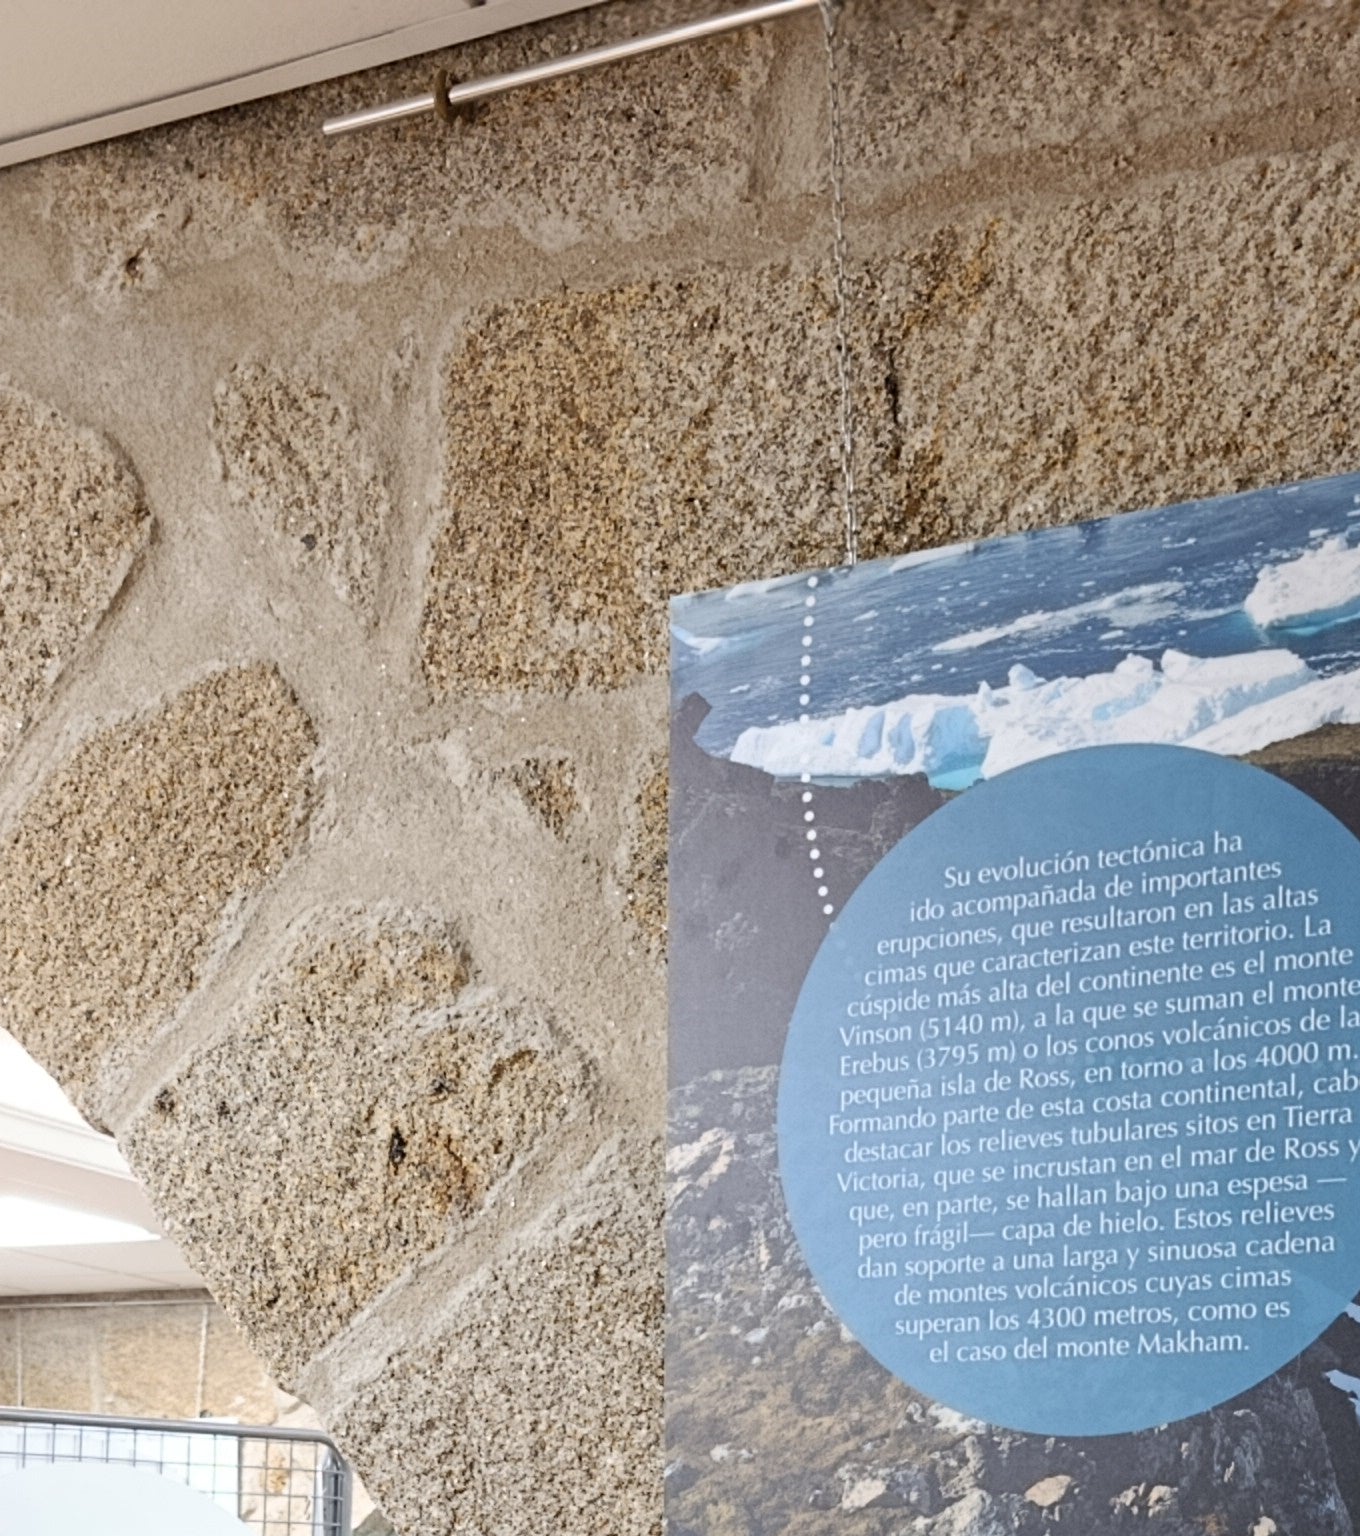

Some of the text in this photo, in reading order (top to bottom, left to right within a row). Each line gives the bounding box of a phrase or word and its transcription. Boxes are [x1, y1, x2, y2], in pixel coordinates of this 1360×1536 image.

[945, 830, 1242, 888] Su evolución tectónica ha
[911, 862, 1282, 922] ido acompañada de importantes
[864, 915, 1331, 986] cimas que caracterizan este territorio. La
[877, 885, 1318, 958] erupciones, que resultaron en las altas
[848, 947, 1354, 1020] cúspide más alta del continente es el monte
[840, 1026, 911, 1046] Vinson
[920, 1014, 983, 1041] (5140
[991, 1011, 1025, 1032] m),
[1034, 1012, 1046, 1027] a
[1056, 1003, 1074, 1025] la
[1083, 1004, 1126, 1029] que
[1134, 1000, 1158, 1017] se
[1166, 991, 1243, 1014] suman
[1252, 980, 1273, 1005] el
[841, 1004, 1360, 1075] Erebus (3795 m) o los conos volcánicos de la
[830, 1107, 936, 1134] Formando
[944, 1105, 999, 1132] parte
[1006, 1098, 1034, 1120] de
[1041, 1097, 1084, 1117] esta
[1093, 1091, 1152, 1112] costa
[1161, 1073, 1303, 1107] continental,
[841, 1042, 1358, 1111] pequeña isla de Ross, en torno a los 4000 m.
[845, 1105, 1352, 1162] destacar los relieves tubulares sitos en Tierra
[837, 1173, 925, 1192] Victoria,
[934, 1169, 974, 1192] que
[983, 1167, 1005, 1181] se
[1014, 1157, 1116, 1179] incrustan
[1125, 1155, 1152, 1171] en
[1161, 1145, 1181, 1169] el
[1191, 1148, 1237, 1166] mar
[1245, 1138, 1275, 1162] de
[1285, 1138, 1340, 1159] Ross
[850, 1205, 894, 1226] que,
[903, 1202, 928, 1216] en
[937, 1195, 997, 1221] parte,
[1007, 1195, 1029, 1210] se
[1038, 1184, 1106, 1207] hallan
[1116, 1180, 1167, 1207] bajo
[1176, 1181, 1218, 1198] una
[1227, 1174, 1307, 1200] espesa
[860, 1233, 907, 1256] pero
[1002, 1223, 1054, 1246] capa
[1063, 1214, 1091, 1236] de
[1100, 1209, 1164, 1234] hielo.
[1175, 1208, 1232, 1229] Estos
[1242, 1200, 1334, 1225] relieves
[858, 1230, 1335, 1281] dan soporte a una larga y sinuosa cadena
[895, 1266, 1292, 1305] de montes volcánicos cuyas cimas
[896, 1302, 1290, 1340] superan los 4300 metros, como es
[930, 1329, 1249, 1362] el caso del monte Makham.
